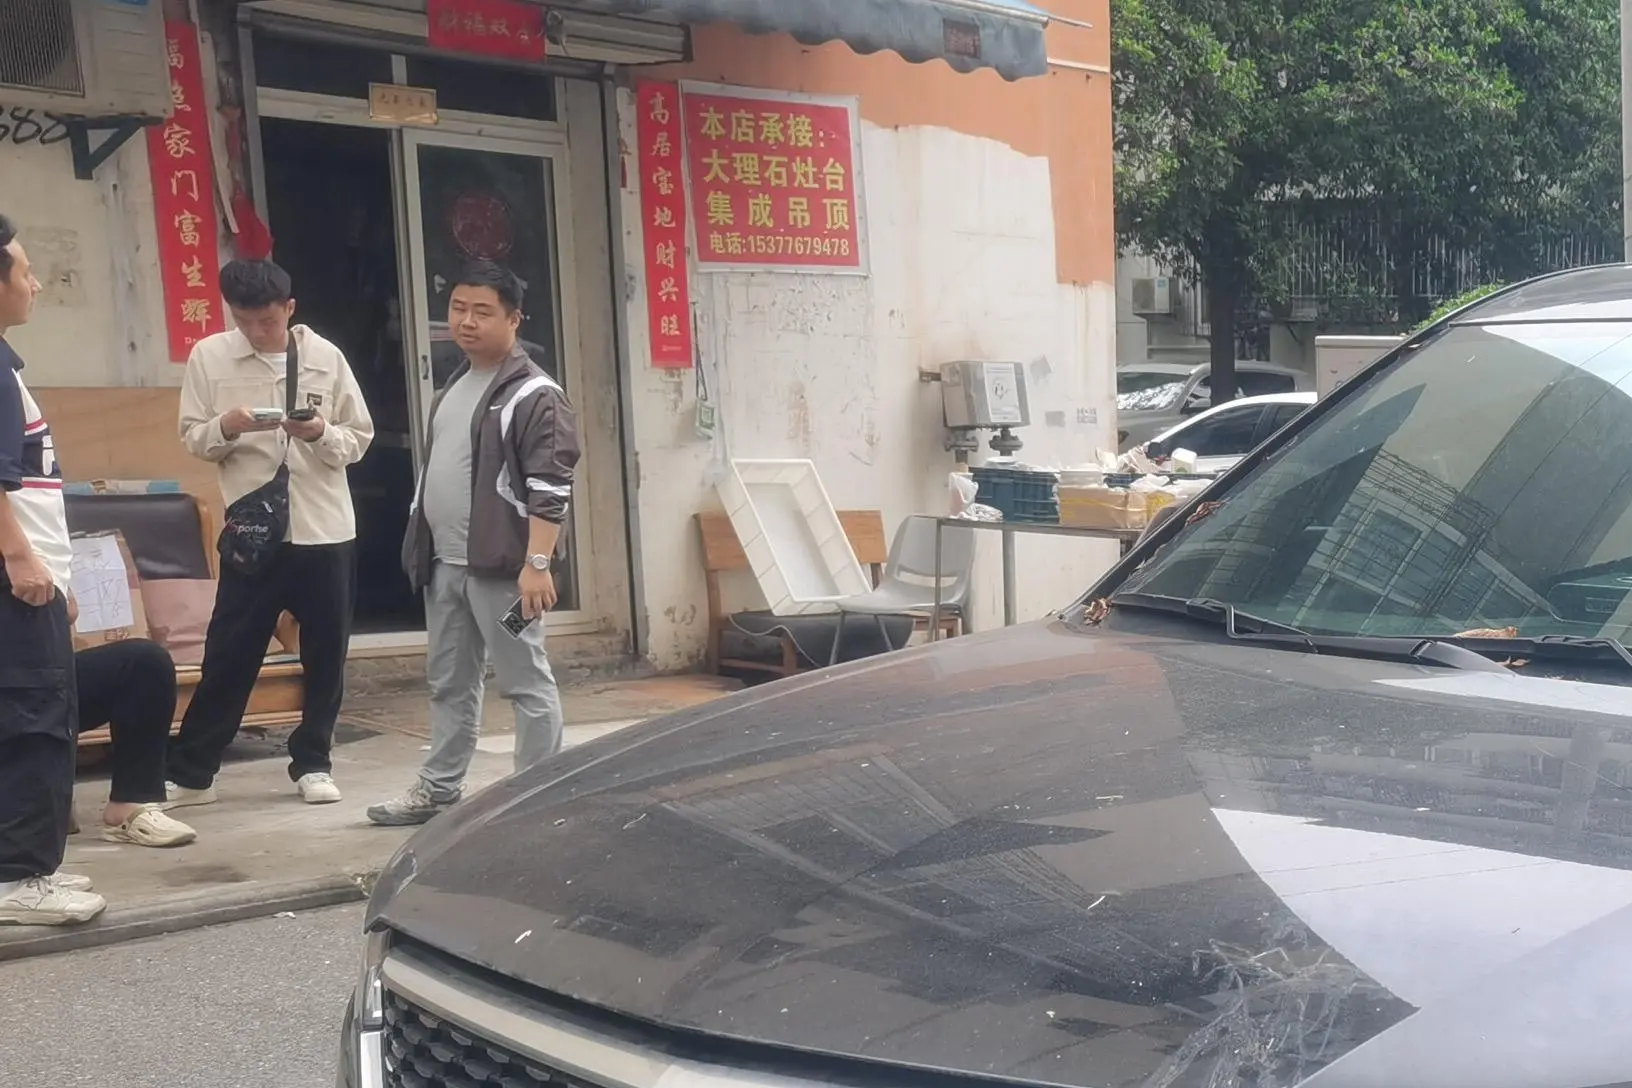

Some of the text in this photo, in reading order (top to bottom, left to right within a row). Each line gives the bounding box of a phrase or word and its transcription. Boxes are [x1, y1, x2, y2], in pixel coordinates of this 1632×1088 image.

[702, 149, 846, 191] 大理石灶台
[648, 91, 681, 336] 高居宝地财兴旺
[705, 190, 850, 230] 集成吊顶
